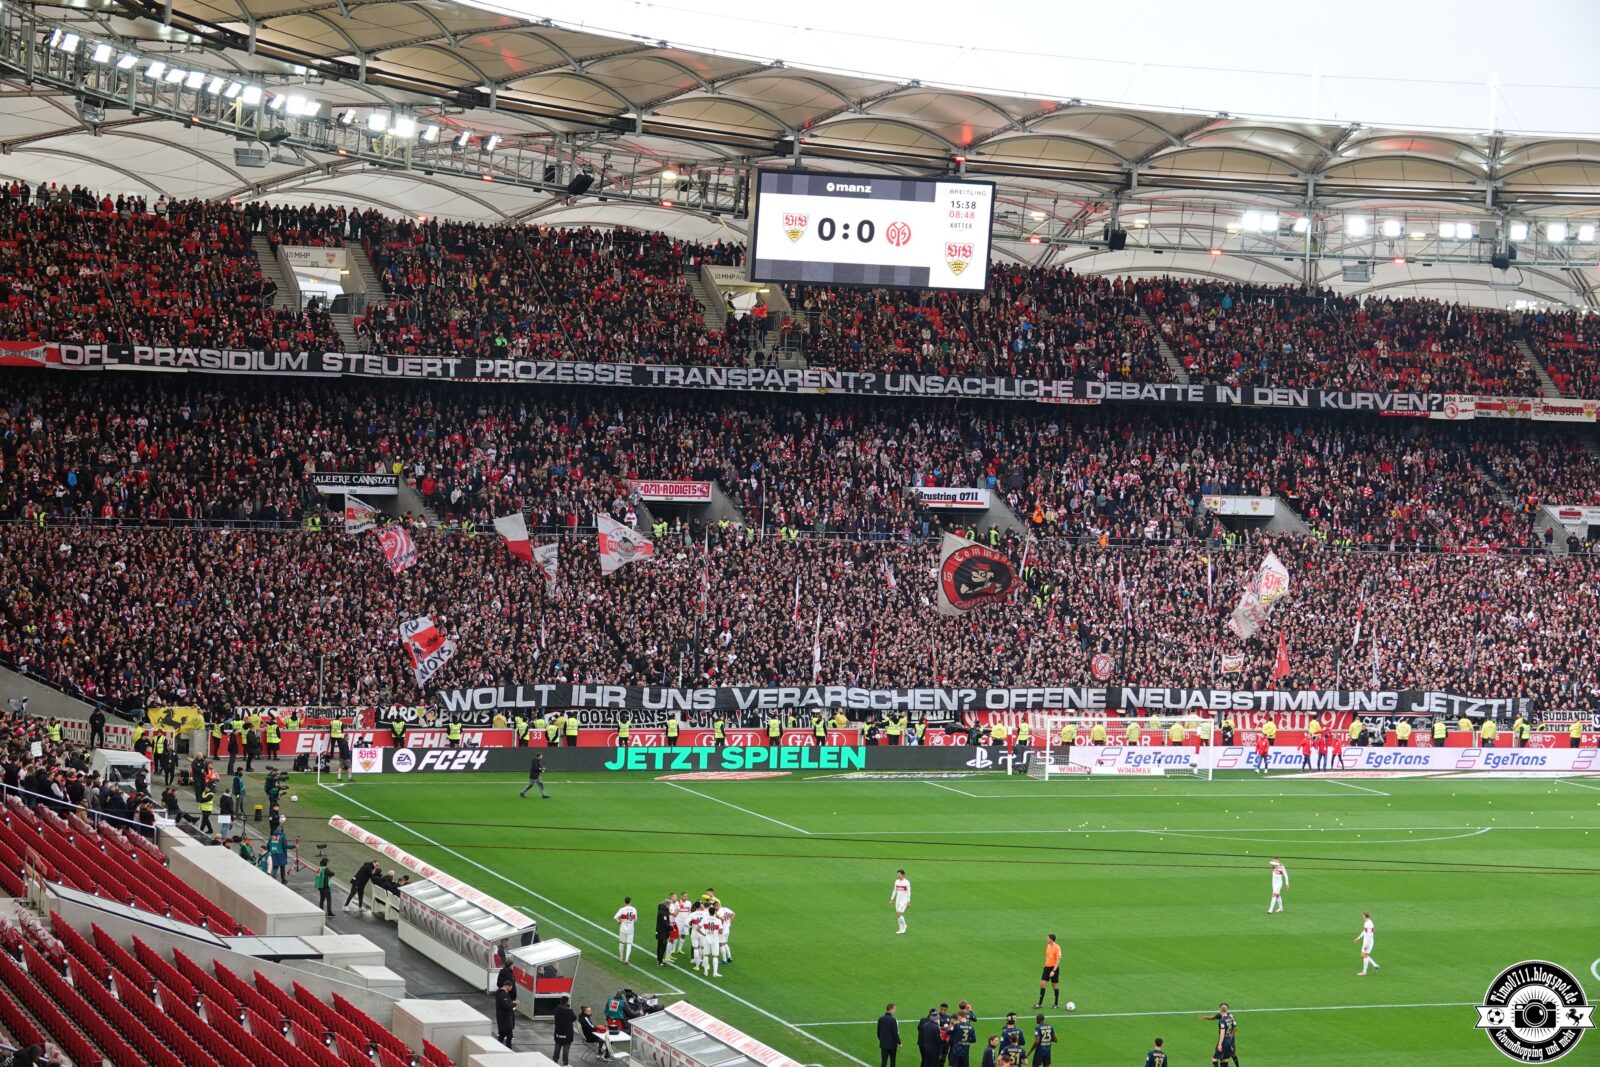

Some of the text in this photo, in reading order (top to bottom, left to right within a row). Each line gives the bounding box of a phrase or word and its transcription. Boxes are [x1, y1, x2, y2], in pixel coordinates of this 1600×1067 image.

[836, 183, 872, 193] manz
[949, 188, 986, 196] BREITLING
[950, 200, 977, 209] 15:38
[948, 210, 975, 219] 08:48
[322, 353, 461, 377] STEUERT
[476, 359, 632, 383] PROZESSE
[646, 366, 876, 389] TRANSPARENT?
[885, 373, 1073, 398] UNSACHLICHE
[1086, 381, 1204, 401] DEBATTE
[1216, 385, 1241, 403] IN
[1254, 387, 1309, 406] DEN
[1320, 391, 1443, 411] KURVEN?
[353, 475, 396, 485] CANNSTATT
[960, 491, 978, 500] 0711
[440, 684, 556, 711] WOLLT
[571, 685, 627, 708] IHR
[642, 687, 716, 710] UNS
[732, 686, 977, 710] VERARSCHEN?
[985, 688, 1107, 709] OFFENE
[1121, 688, 1398, 711] NEUABSTIMMUNG
[1412, 691, 1513, 718] JETZT!
[380, 705, 420, 721] YARD
[532, 731, 542, 739] 33
[397, 753, 412, 761] EA
[418, 750, 488, 770] FC24
[604, 746, 866, 771] JETZT SPIELEN
[1125, 751, 1190, 766] EgeTrans
[1365, 752, 1430, 767] EgeTrans
[1483, 752, 1547, 767] EgeTrans
[961, 1028, 968, 1042] 3
[1041, 1028, 1051, 1042] 23
[1009, 1052, 1021, 1065] 31
